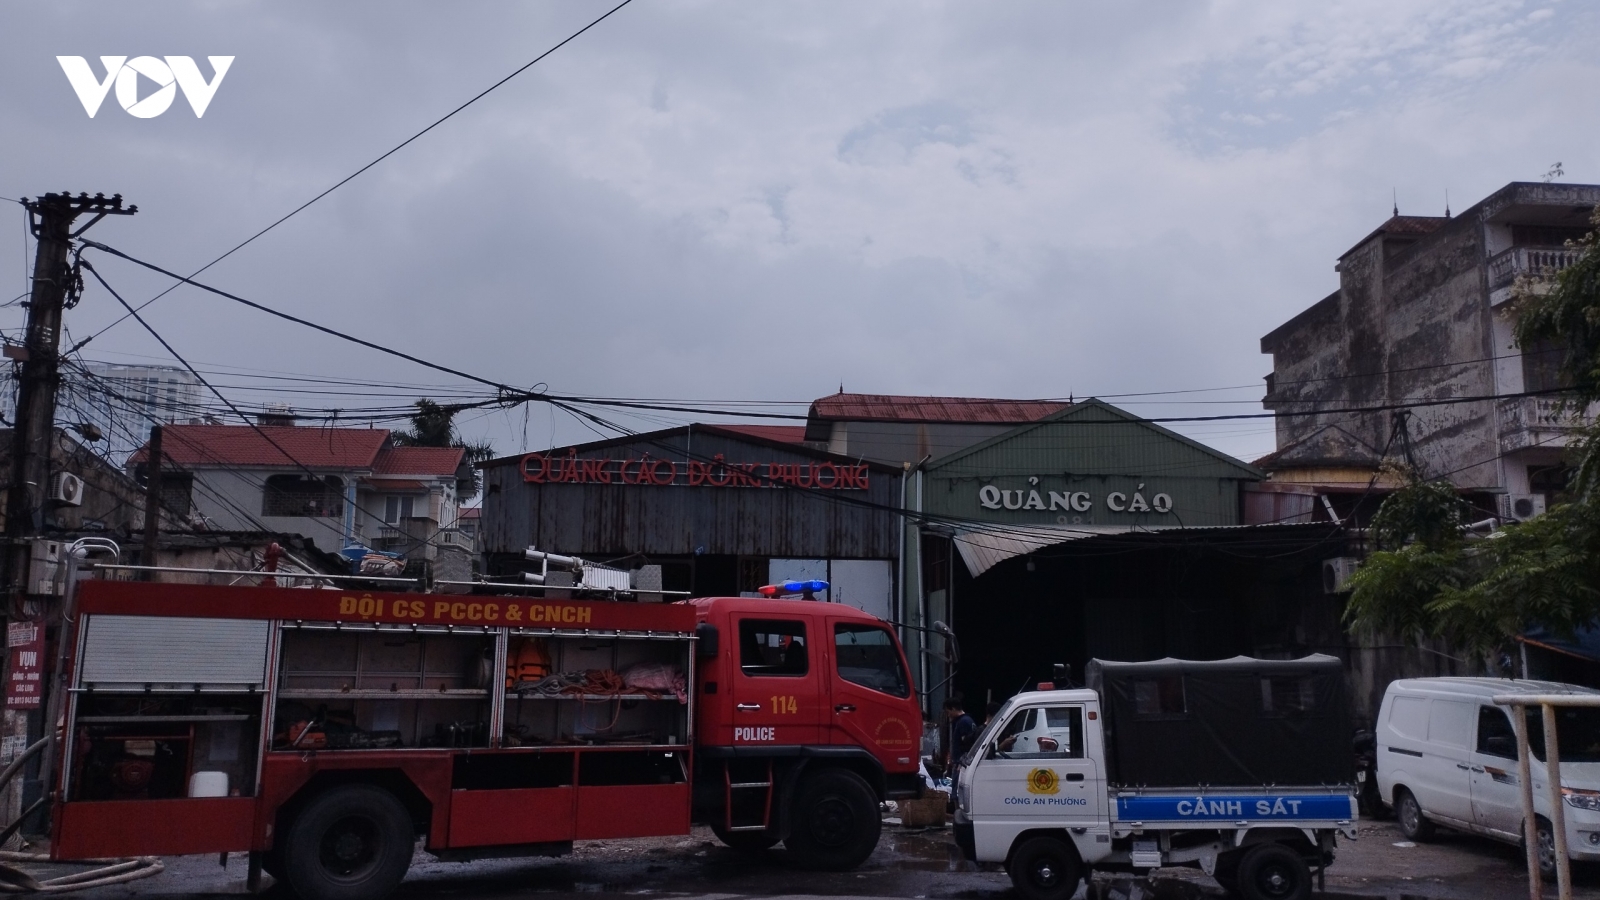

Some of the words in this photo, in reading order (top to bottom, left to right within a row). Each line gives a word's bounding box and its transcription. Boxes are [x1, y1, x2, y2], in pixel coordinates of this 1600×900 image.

[520, 447, 611, 484] QUẢNG
[769, 460, 869, 490] PHƯƠNG
[979, 476, 1092, 512] QUẢNG
[1107, 483, 1173, 513] CÁO
[339, 593, 384, 620] ĐỘI
[392, 600, 426, 619] CS
[434, 601, 500, 621] PCCC
[505, 603, 523, 621] &
[529, 604, 591, 623] CNCH
[19, 651, 37, 670] VỤN
[770, 695, 797, 714] 114
[734, 727, 775, 741] POLICE
[1004, 796, 1031, 805] CÔNG
[1048, 796, 1087, 806] PHƯỜNG
[1176, 796, 1242, 816] CẢNH
[1256, 797, 1302, 815] SÁT
